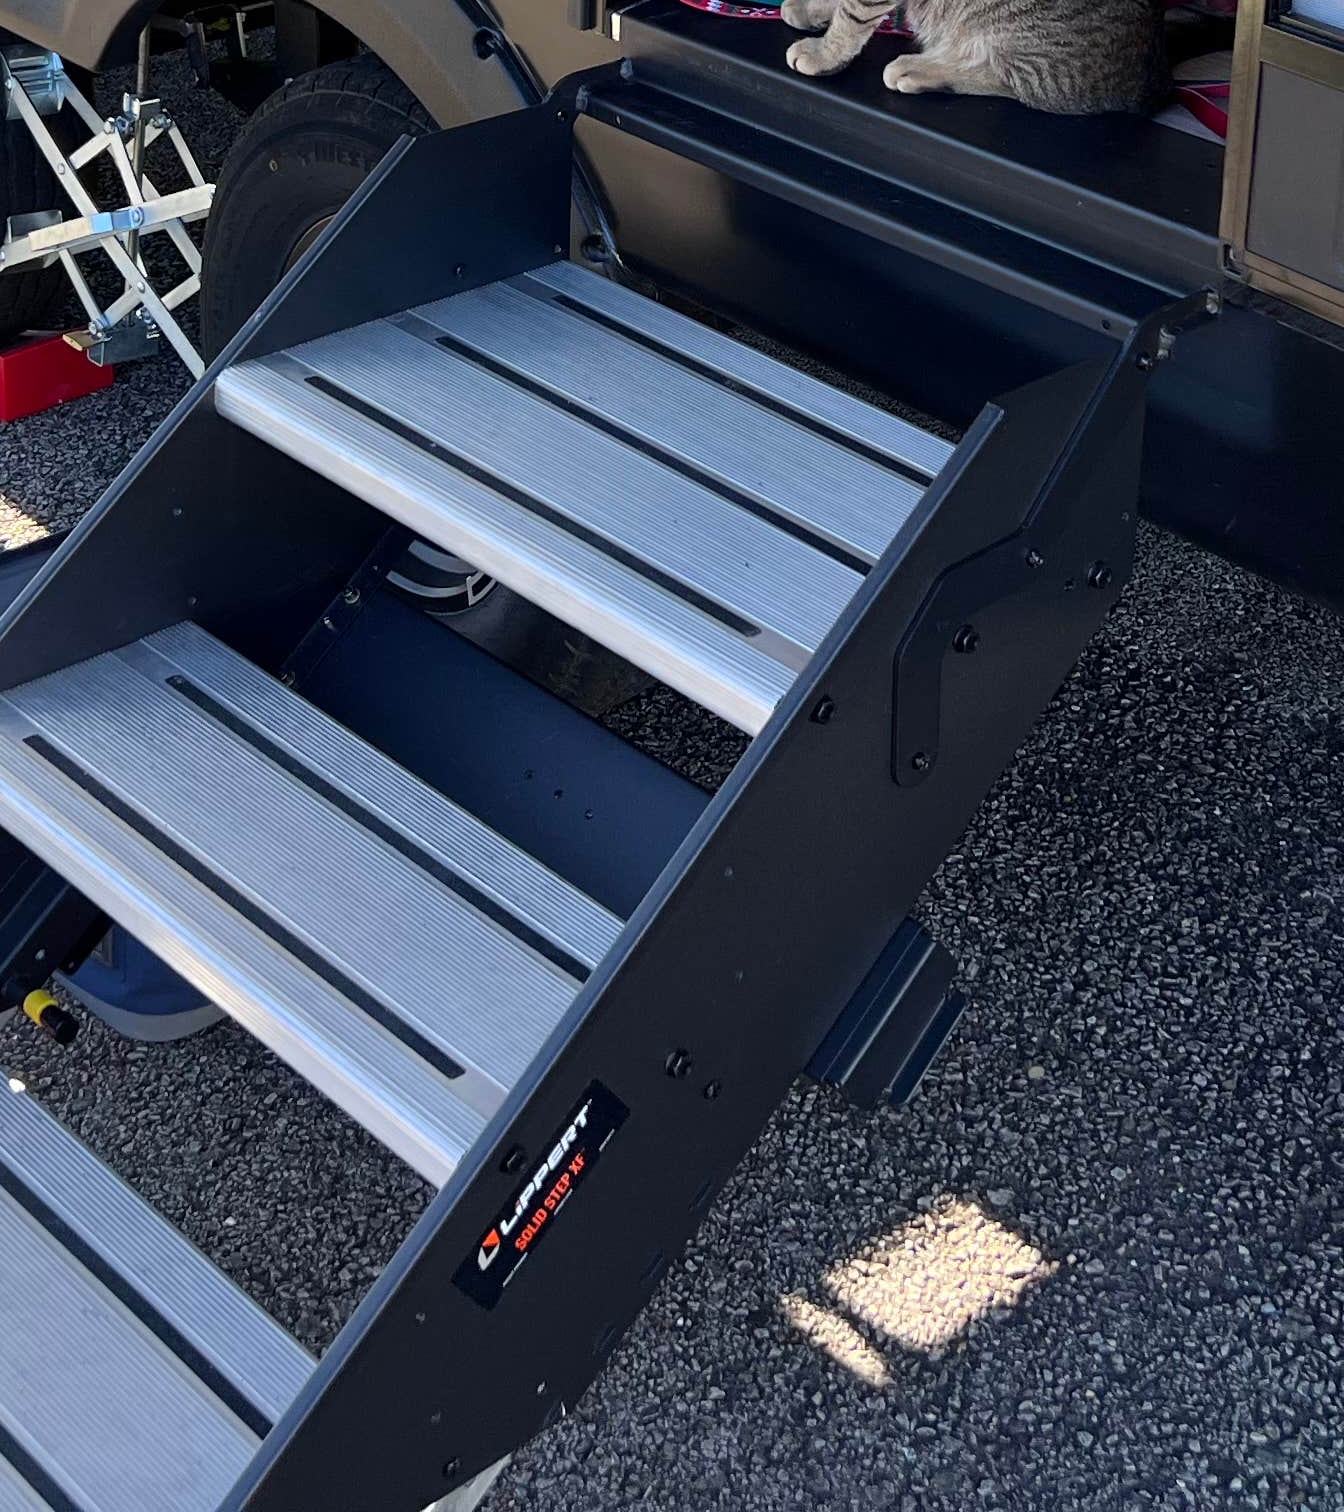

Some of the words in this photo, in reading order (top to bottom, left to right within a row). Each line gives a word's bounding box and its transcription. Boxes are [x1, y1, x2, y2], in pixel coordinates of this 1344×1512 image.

[514, 1207, 549, 1252] SOLID
[543, 1172, 571, 1212] STEP
[568, 1152, 587, 1176] XF
